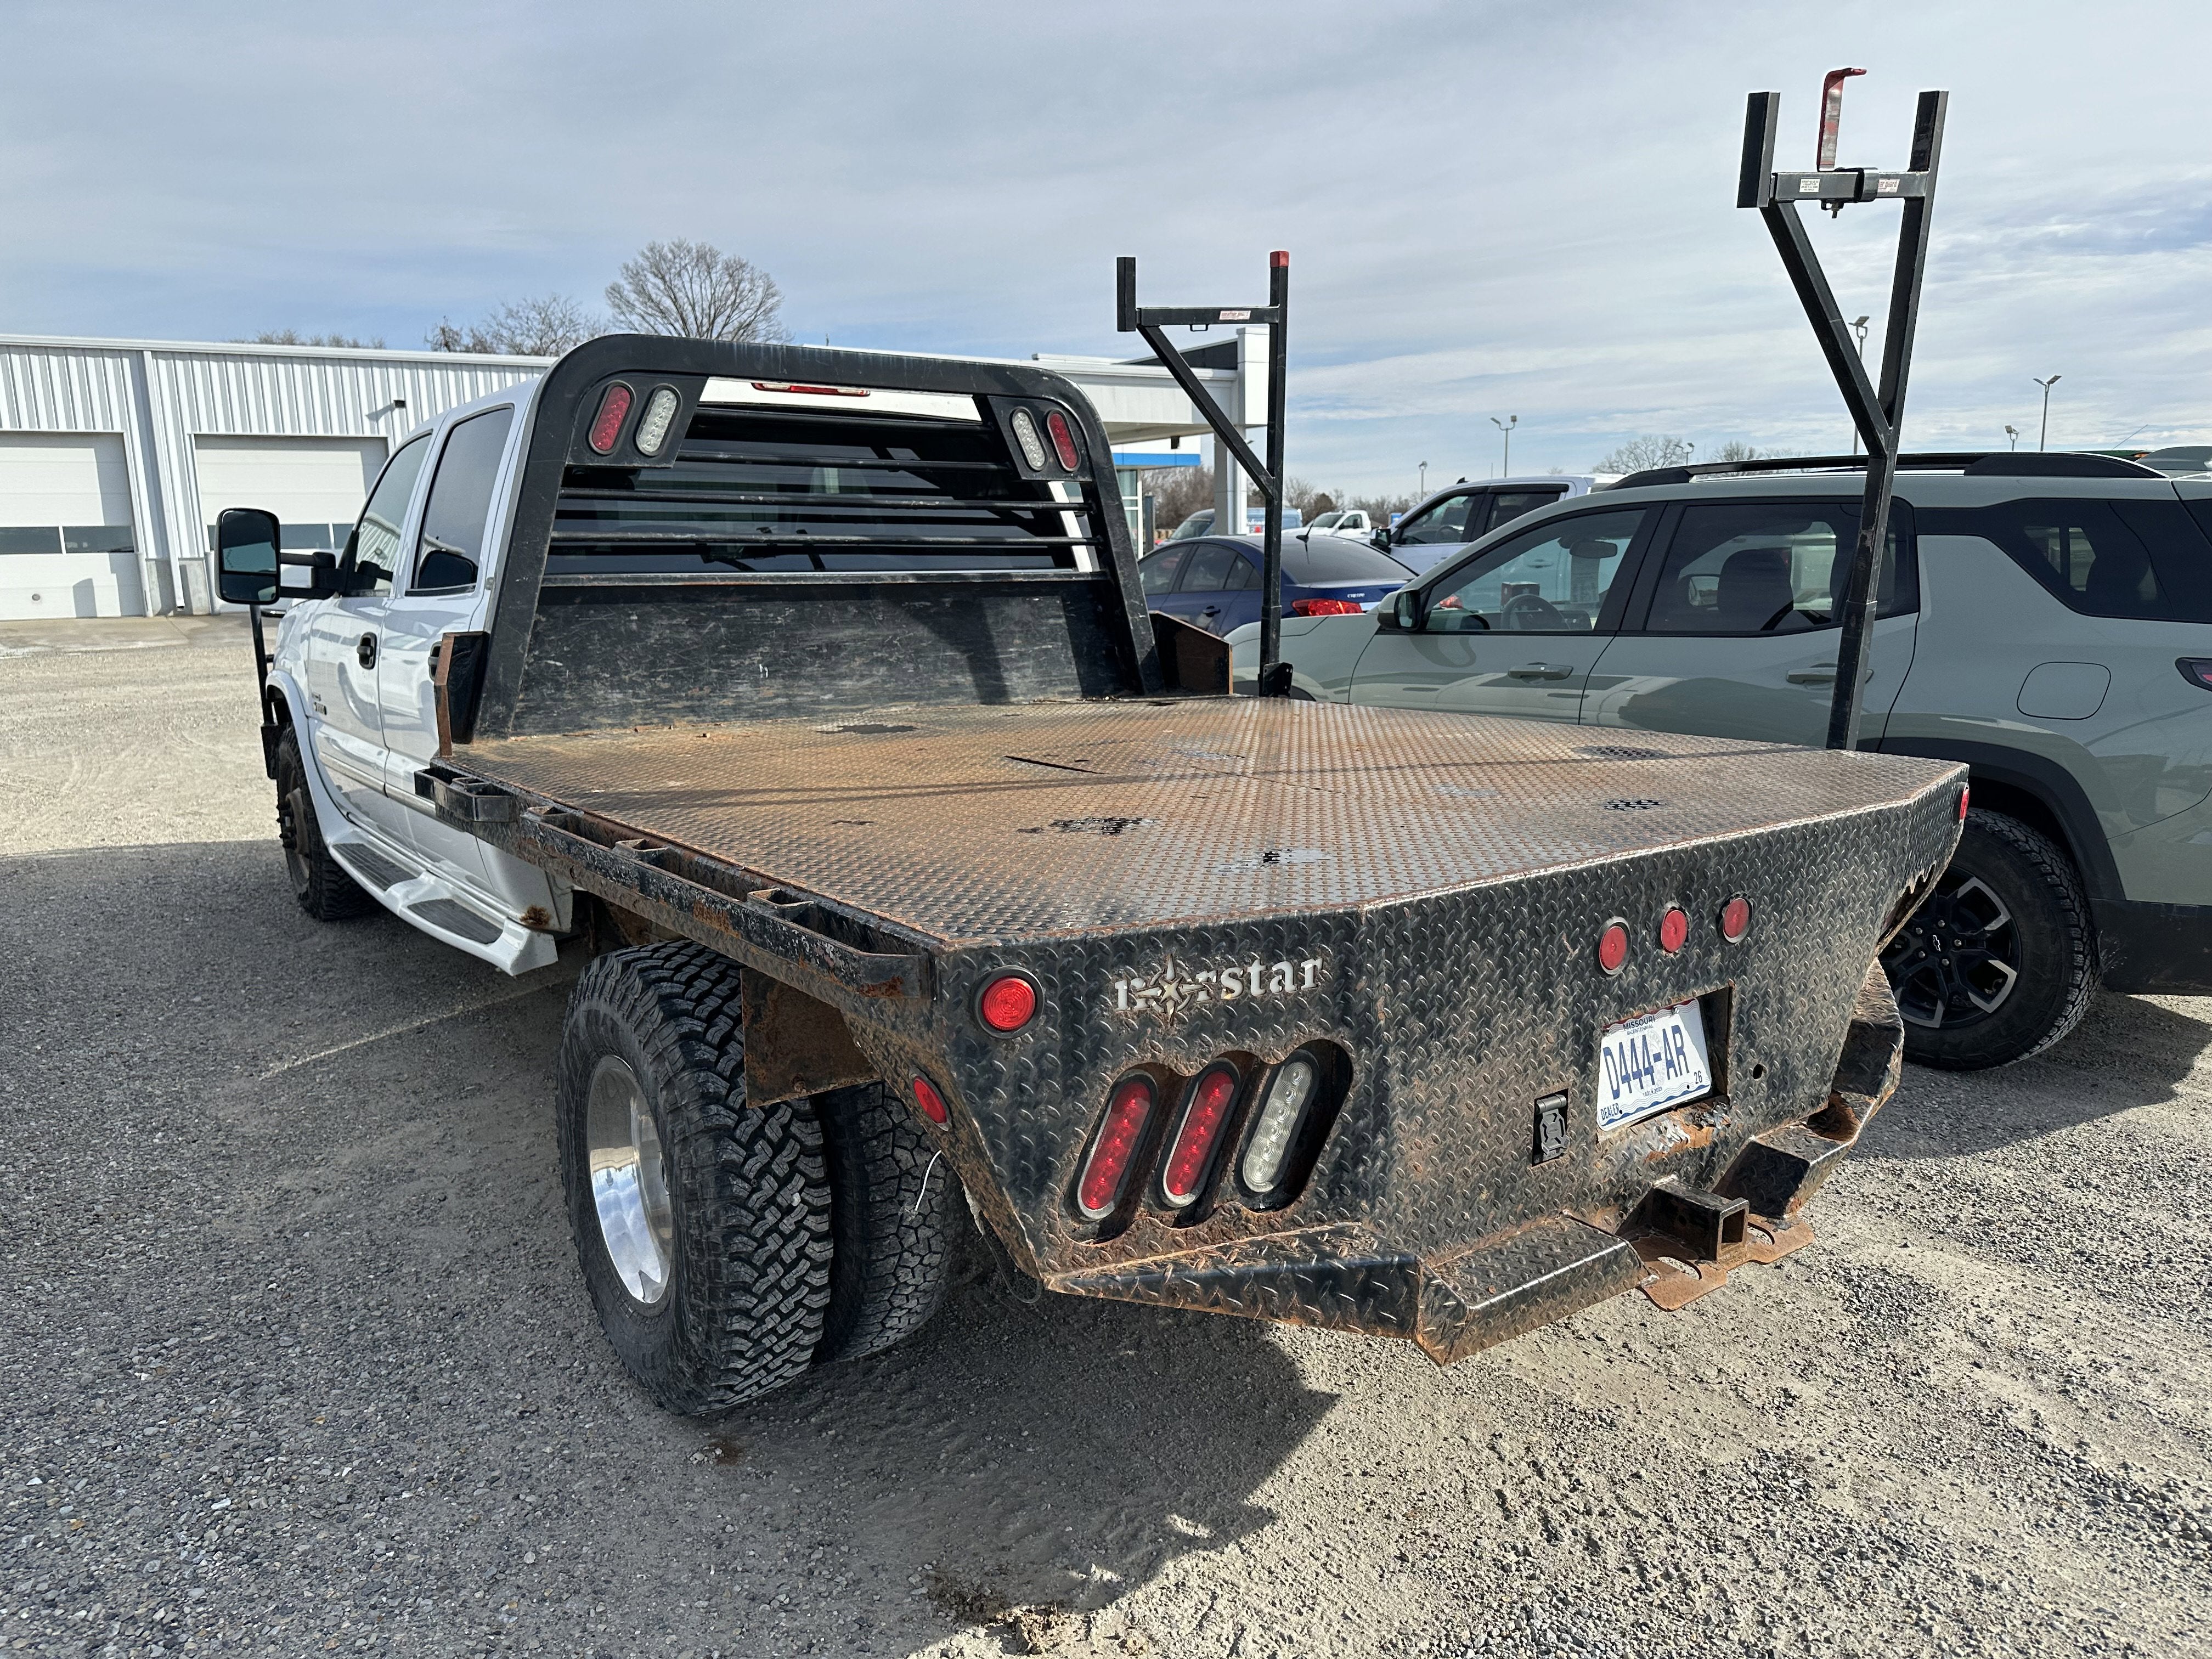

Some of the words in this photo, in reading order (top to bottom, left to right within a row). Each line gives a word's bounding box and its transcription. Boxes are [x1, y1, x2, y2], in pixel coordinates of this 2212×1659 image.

[1623, 1015, 1655, 1031] MISSOURI
[1602, 1024, 1690, 1100] D444-AR
[1694, 1070, 1702, 1085] 26
[1600, 1103, 1620, 1120] DEALER
